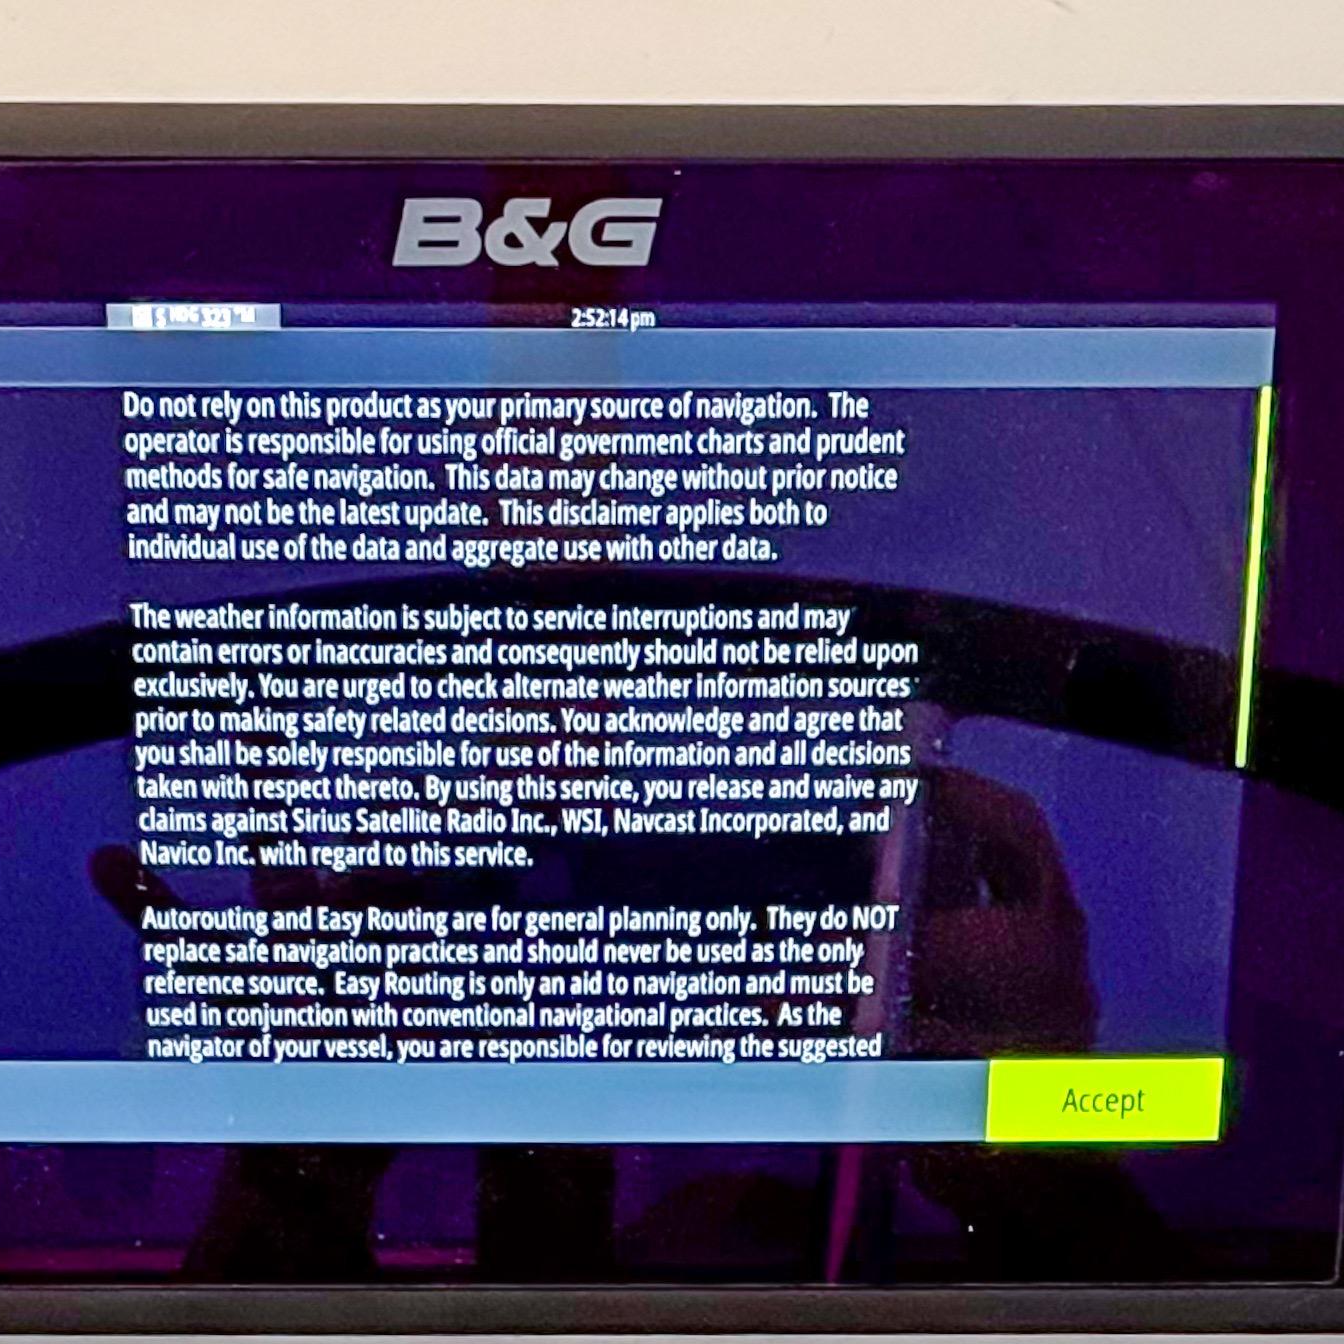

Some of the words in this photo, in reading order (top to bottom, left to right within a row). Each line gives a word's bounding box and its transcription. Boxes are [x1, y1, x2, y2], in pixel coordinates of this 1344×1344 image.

[392, 197, 663, 267] B&G
[124, 391, 154, 417] Do
[160, 394, 196, 417] not
[202, 390, 242, 425] rely
[247, 397, 275, 418] on
[280, 391, 321, 418] this
[326, 391, 412, 425] product
[417, 398, 441, 418] as
[445, 398, 496, 425] your
[501, 392, 587, 426] primary
[591, 398, 663, 418] source
[669, 391, 693, 418] of
[697, 392, 817, 425] navigation.
[828, 391, 868, 418] The
[125, 430, 220, 460] operator
[226, 427, 243, 453] is
[248, 427, 375, 461] responsible
[380, 427, 412, 454] for
[418, 428, 477, 461] using
[482, 427, 554, 454] official
[560, 431, 693, 461] government
[697, 427, 764, 454] charts
[769, 427, 810, 454] and
[817, 427, 905, 461] prudent
[126, 462, 222, 489] methods
[228, 462, 259, 489] for
[263, 462, 308, 489] safe
[314, 463, 434, 496] navigation.
[445, 463, 490, 490] This
[495, 463, 543, 490] data
[549, 469, 595, 497] may
[599, 463, 678, 497] change
[682, 463, 767, 490] without
[772, 463, 826, 496] prior
[831, 463, 897, 489] notice
[130, 602, 170, 629] The
[175, 603, 264, 629] weather
[269, 603, 396, 630] information
[403, 604, 419, 629] is
[424, 604, 502, 636] subject
[506, 607, 528, 630] to
[533, 604, 606, 629] service
[612, 604, 752, 636] interruptions
[758, 603, 799, 629] and
[804, 609, 850, 636] may
[132, 638, 212, 663] contain
[218, 644, 282, 664] errors
[287, 644, 311, 664] or
[316, 638, 446, 664] inaccuracies
[452, 638, 492, 664] and
[498, 638, 640, 671] consequently
[644, 638, 717, 664] should
[723, 641, 759, 664] not
[764, 638, 790, 663] be
[796, 637, 857, 663] relied
[863, 644, 918, 670] upon
[139, 806, 206, 832] claims
[212, 807, 288, 838] against
[292, 807, 351, 833] Sirius
[356, 808, 442, 833] Satellite
[448, 808, 506, 833] Radio
[512, 808, 557, 837] Inc.,
[562, 808, 608, 836] WSI,
[614, 808, 696, 833] Navcast
[700, 806, 843, 839] Incorporated,
[849, 806, 889, 831] and
[141, 840, 211, 865] Navico
[215, 840, 256, 865] Inc.
[260, 840, 306, 865] with
[312, 840, 380, 872] regard
[384, 843, 406, 866] to
[411, 841, 450, 866] this
[455, 841, 533, 866] service.
[142, 906, 268, 937] Autorouting
[272, 906, 312, 930] and
[318, 906, 363, 937] Easy
[368, 907, 448, 937] Routing
[452, 912, 486, 931] are
[492, 905, 522, 931] for
[525, 906, 604, 937] general
[610, 906, 701, 937] planning
[706, 905, 756, 937] only.
[767, 906, 816, 936] They
[820, 905, 847, 930] do
[853, 905, 899, 929] NOT
[147, 1002, 196, 1026] used
[201, 1002, 221, 1026] in
[226, 1003, 348, 1032] conjunction
[352, 1002, 398, 1026] with
[403, 1002, 534, 1026] conventional
[540, 1002, 665, 1033] navigational
[670, 1002, 768, 1032] practices.
[778, 1002, 802, 1026] As
[808, 1001, 842, 1025] the
[1061, 1088, 1146, 1119] Accept
